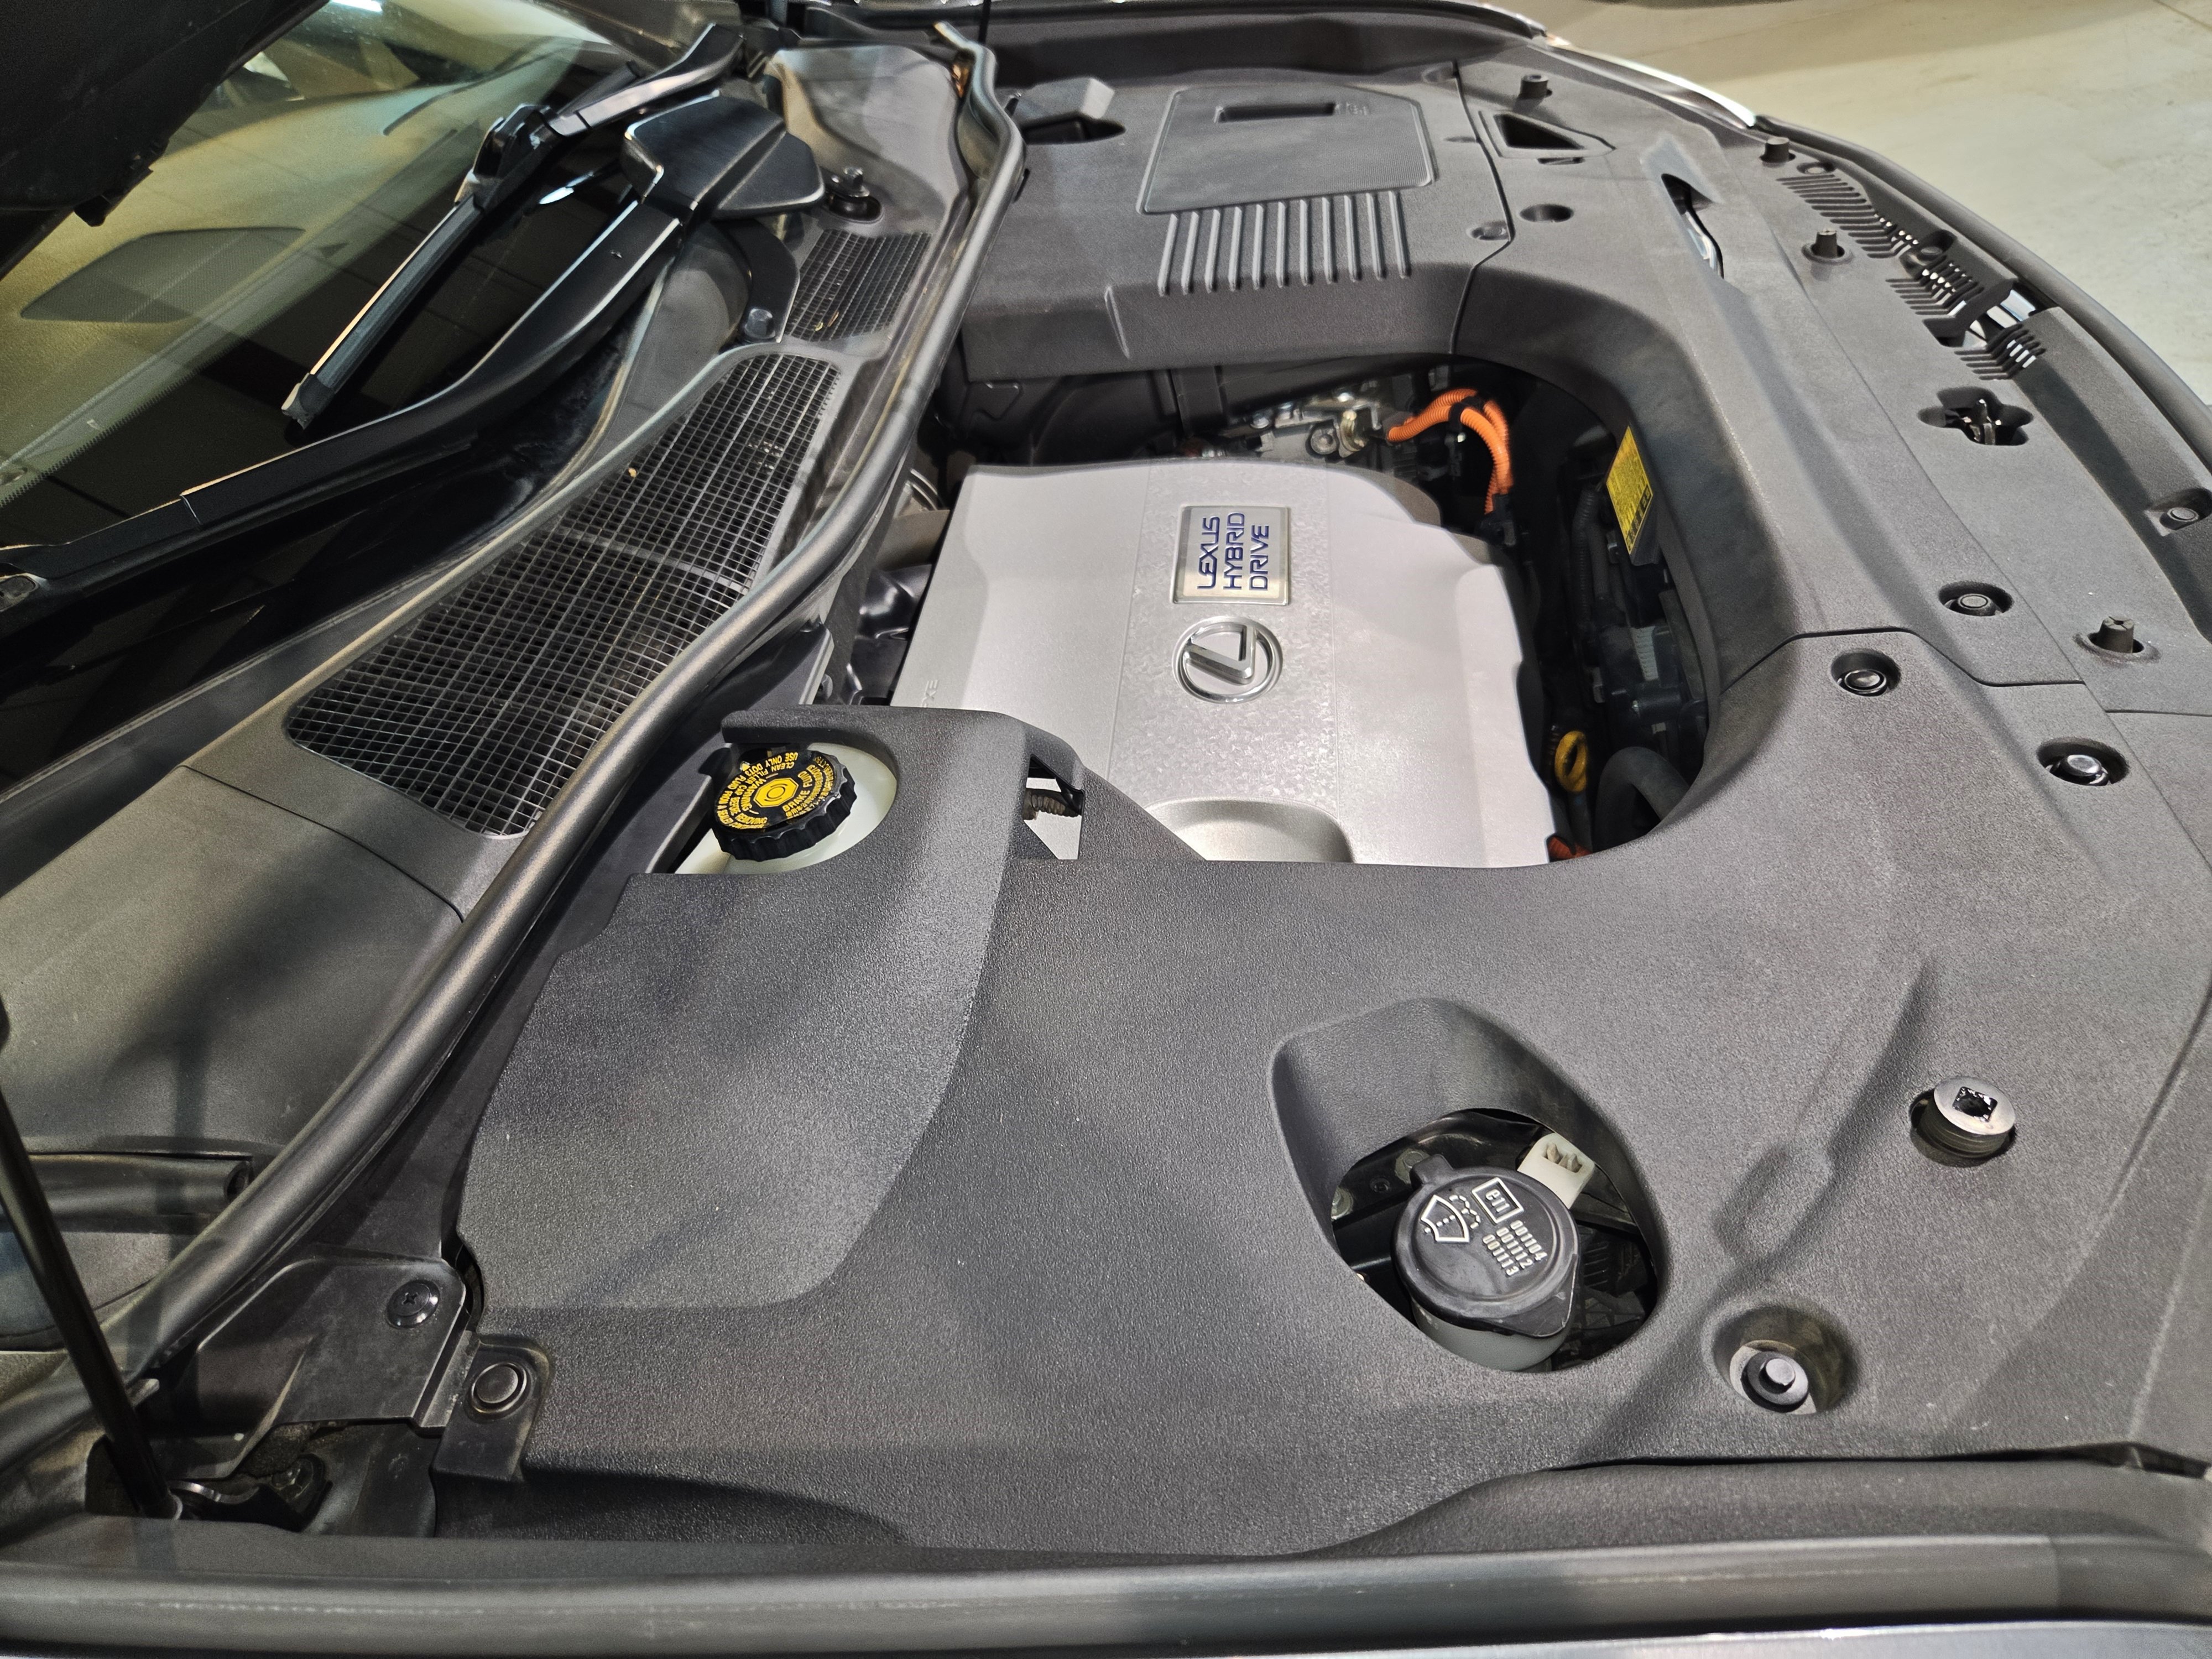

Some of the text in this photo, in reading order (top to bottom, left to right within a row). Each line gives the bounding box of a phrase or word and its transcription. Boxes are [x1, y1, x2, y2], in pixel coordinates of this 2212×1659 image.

[1197, 516, 1220, 589] LEXUS
[1223, 513, 1245, 589] HYBRID
[1249, 525, 1269, 591] DRIVE
[745, 763, 763, 776] DOT3
[765, 755, 782, 767] ONLY
[771, 761, 794, 772] CLEAN
[785, 752, 798, 761] USE
[728, 775, 746, 789] FLUID
[734, 785, 747, 795] CAP
[745, 769, 768, 784] FILLER
[741, 778, 766, 811] WARNING
[782, 790, 810, 812] BRAKE
[797, 771, 812, 787] FLUID
[1486, 1189, 1510, 1213] e11
[1496, 1227, 1533, 1269] 001112
[1510, 1220, 1548, 1261] 001104
[1483, 1234, 1520, 1276] 001113
